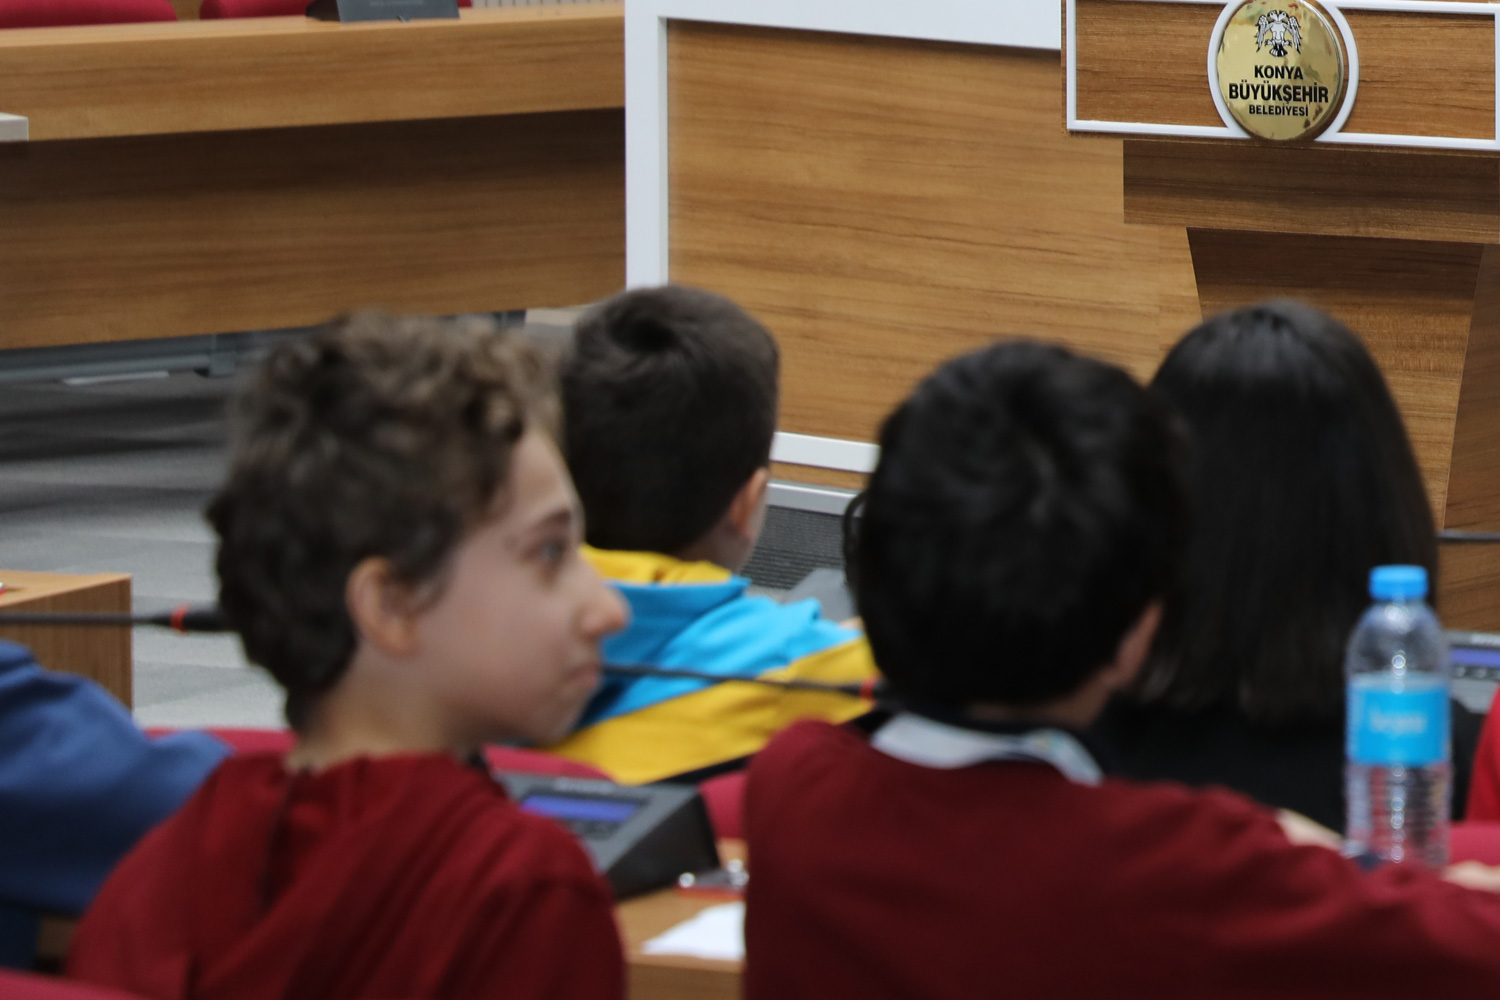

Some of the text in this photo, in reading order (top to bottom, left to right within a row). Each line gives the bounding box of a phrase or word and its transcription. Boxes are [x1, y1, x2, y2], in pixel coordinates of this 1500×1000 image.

[1254, 65, 1303, 80] KONYA
[1229, 79, 1329, 104] BÜYÜKŞEHİR
[1249, 104, 1309, 117] BELEDİYESİ
